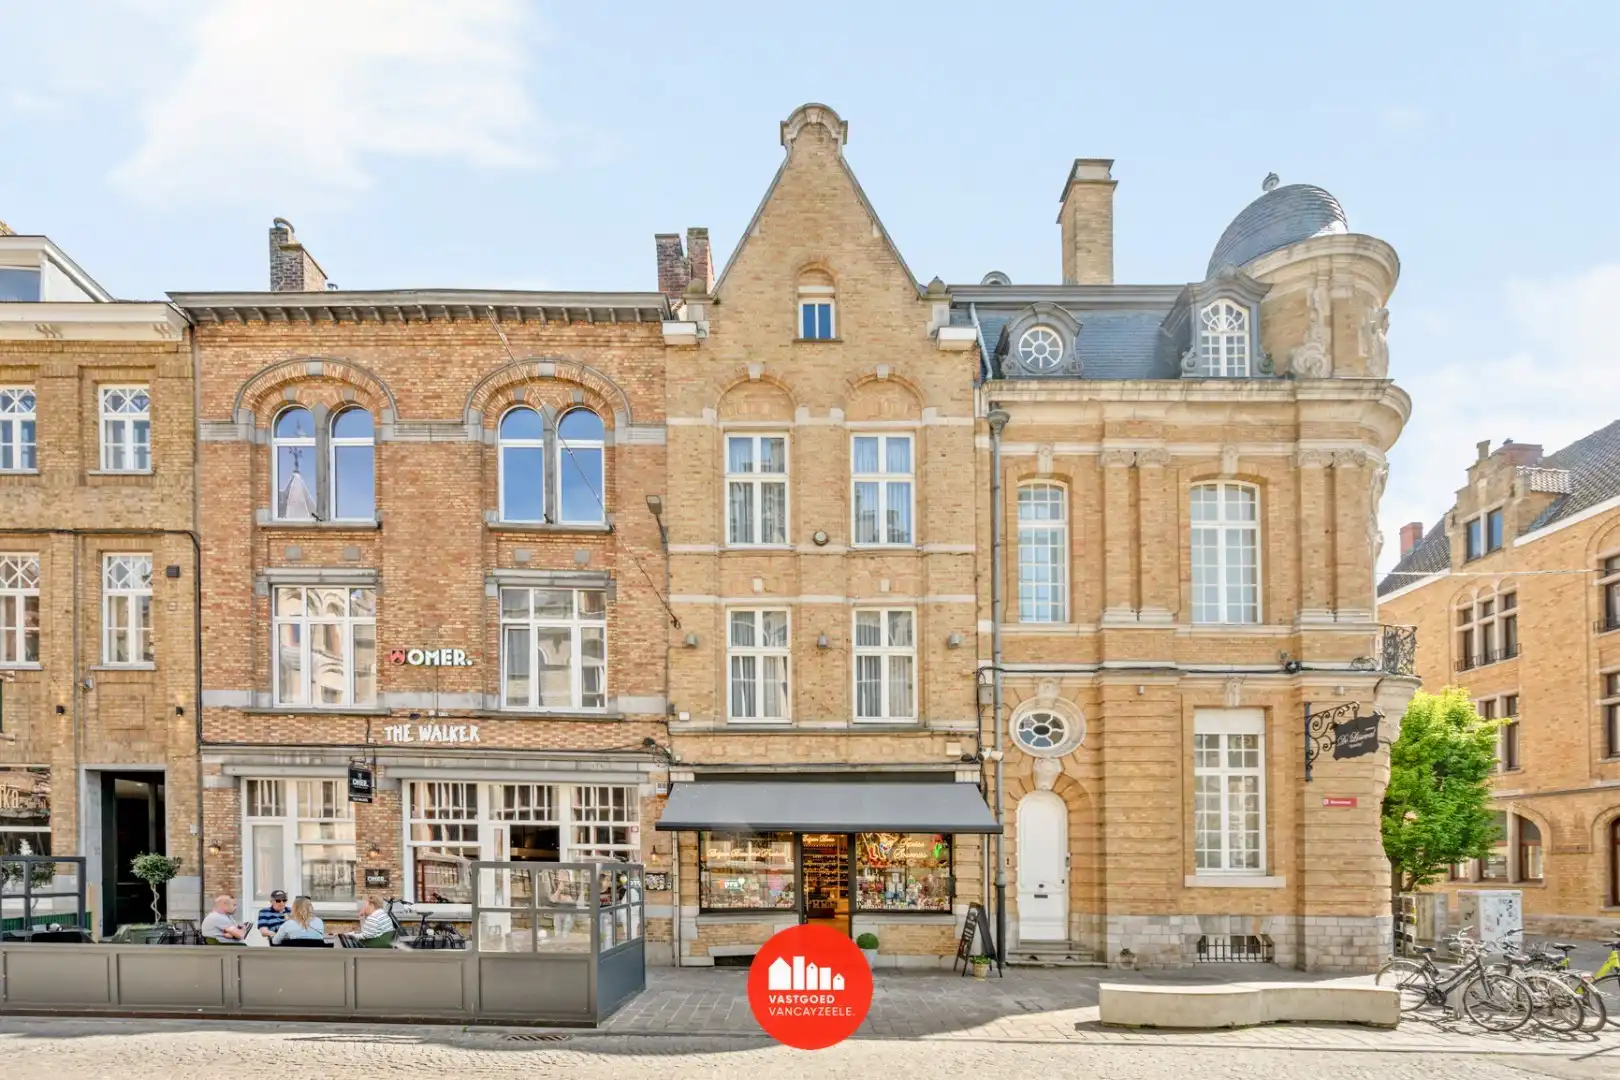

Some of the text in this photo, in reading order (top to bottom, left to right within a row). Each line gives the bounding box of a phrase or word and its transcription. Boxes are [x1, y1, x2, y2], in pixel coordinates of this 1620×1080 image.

[407, 648, 473, 666] OMER.
[384, 723, 481, 743] THE WALKER
